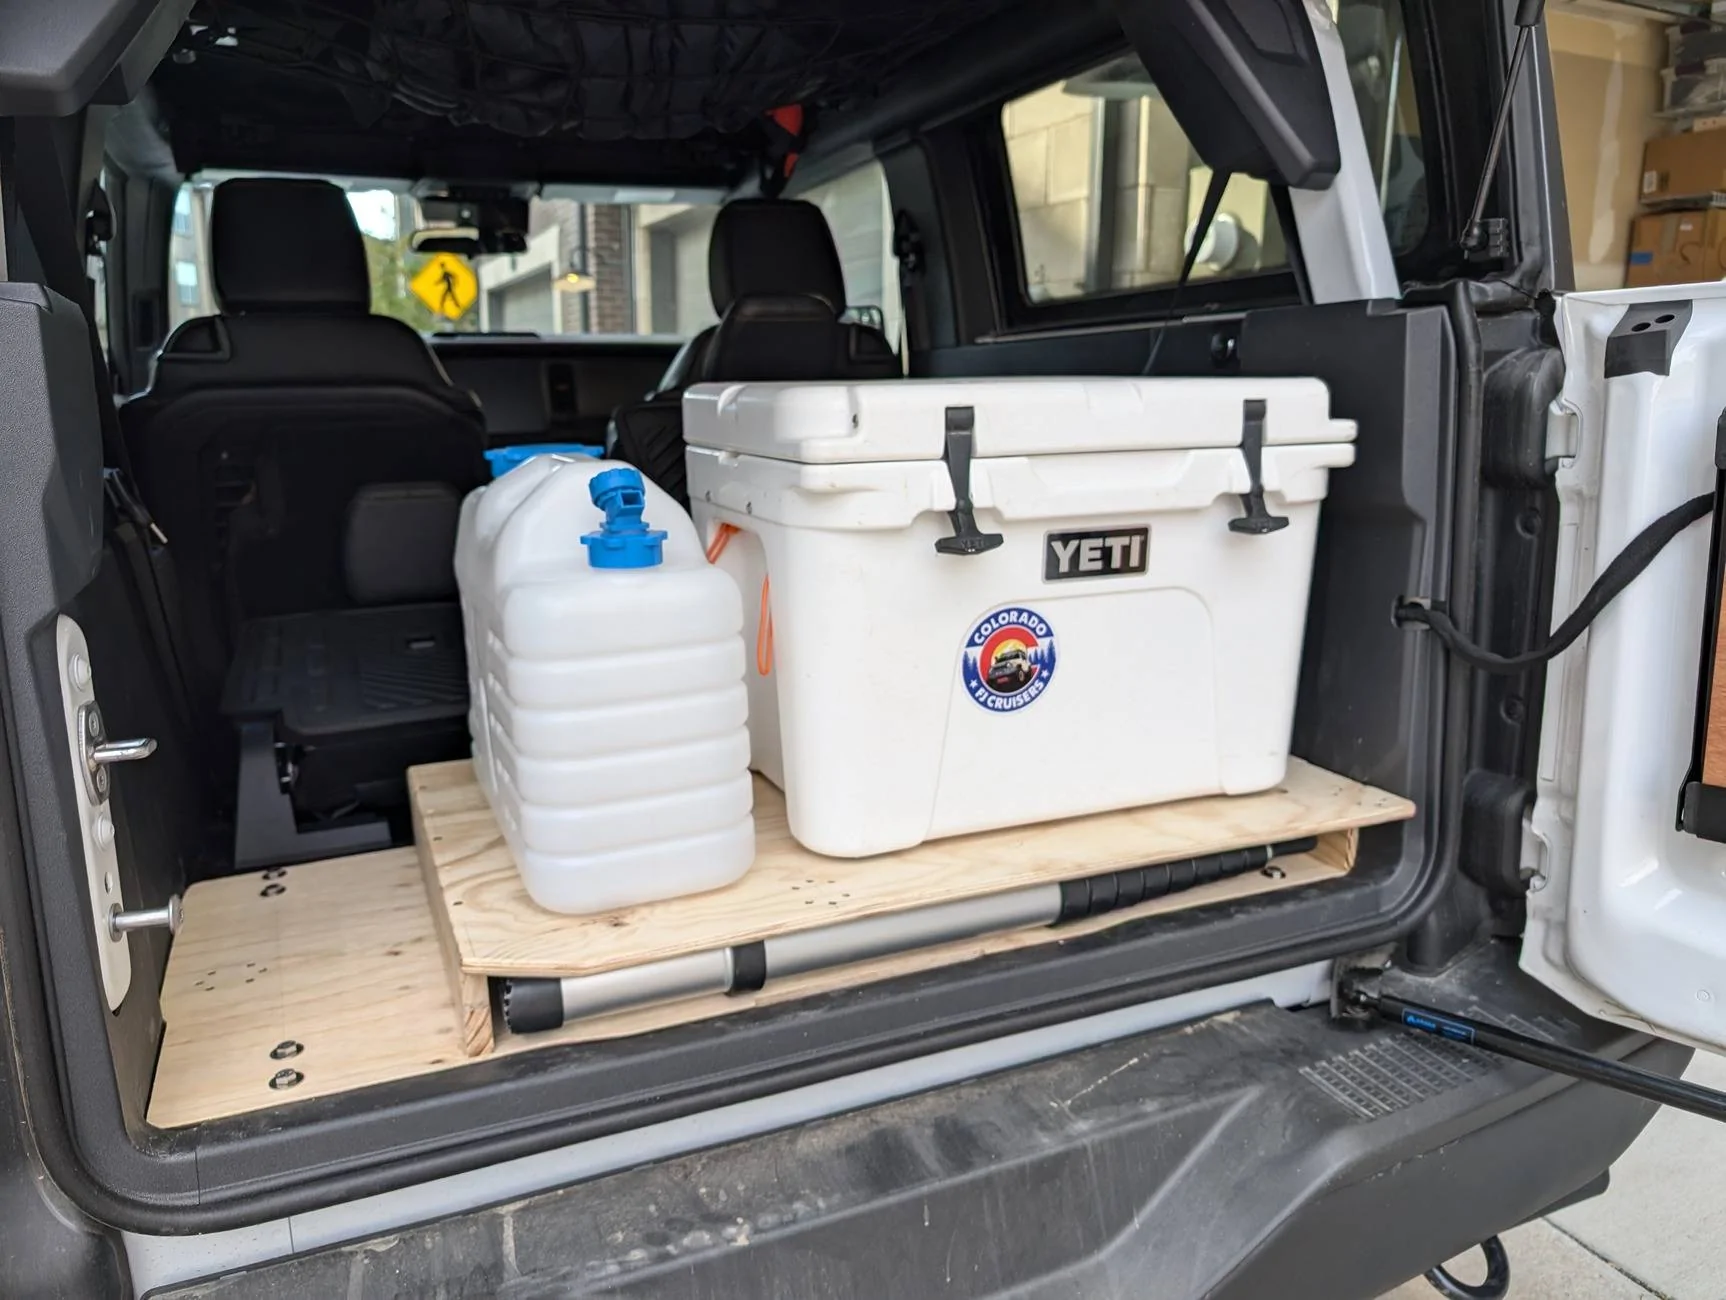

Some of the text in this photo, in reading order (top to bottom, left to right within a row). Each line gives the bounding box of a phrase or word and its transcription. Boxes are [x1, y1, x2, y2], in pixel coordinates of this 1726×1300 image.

[1051, 535, 1141, 573] YETI
[974, 610, 1047, 644] COLORADO
[975, 679, 1044, 709] FJ CRUISERS
